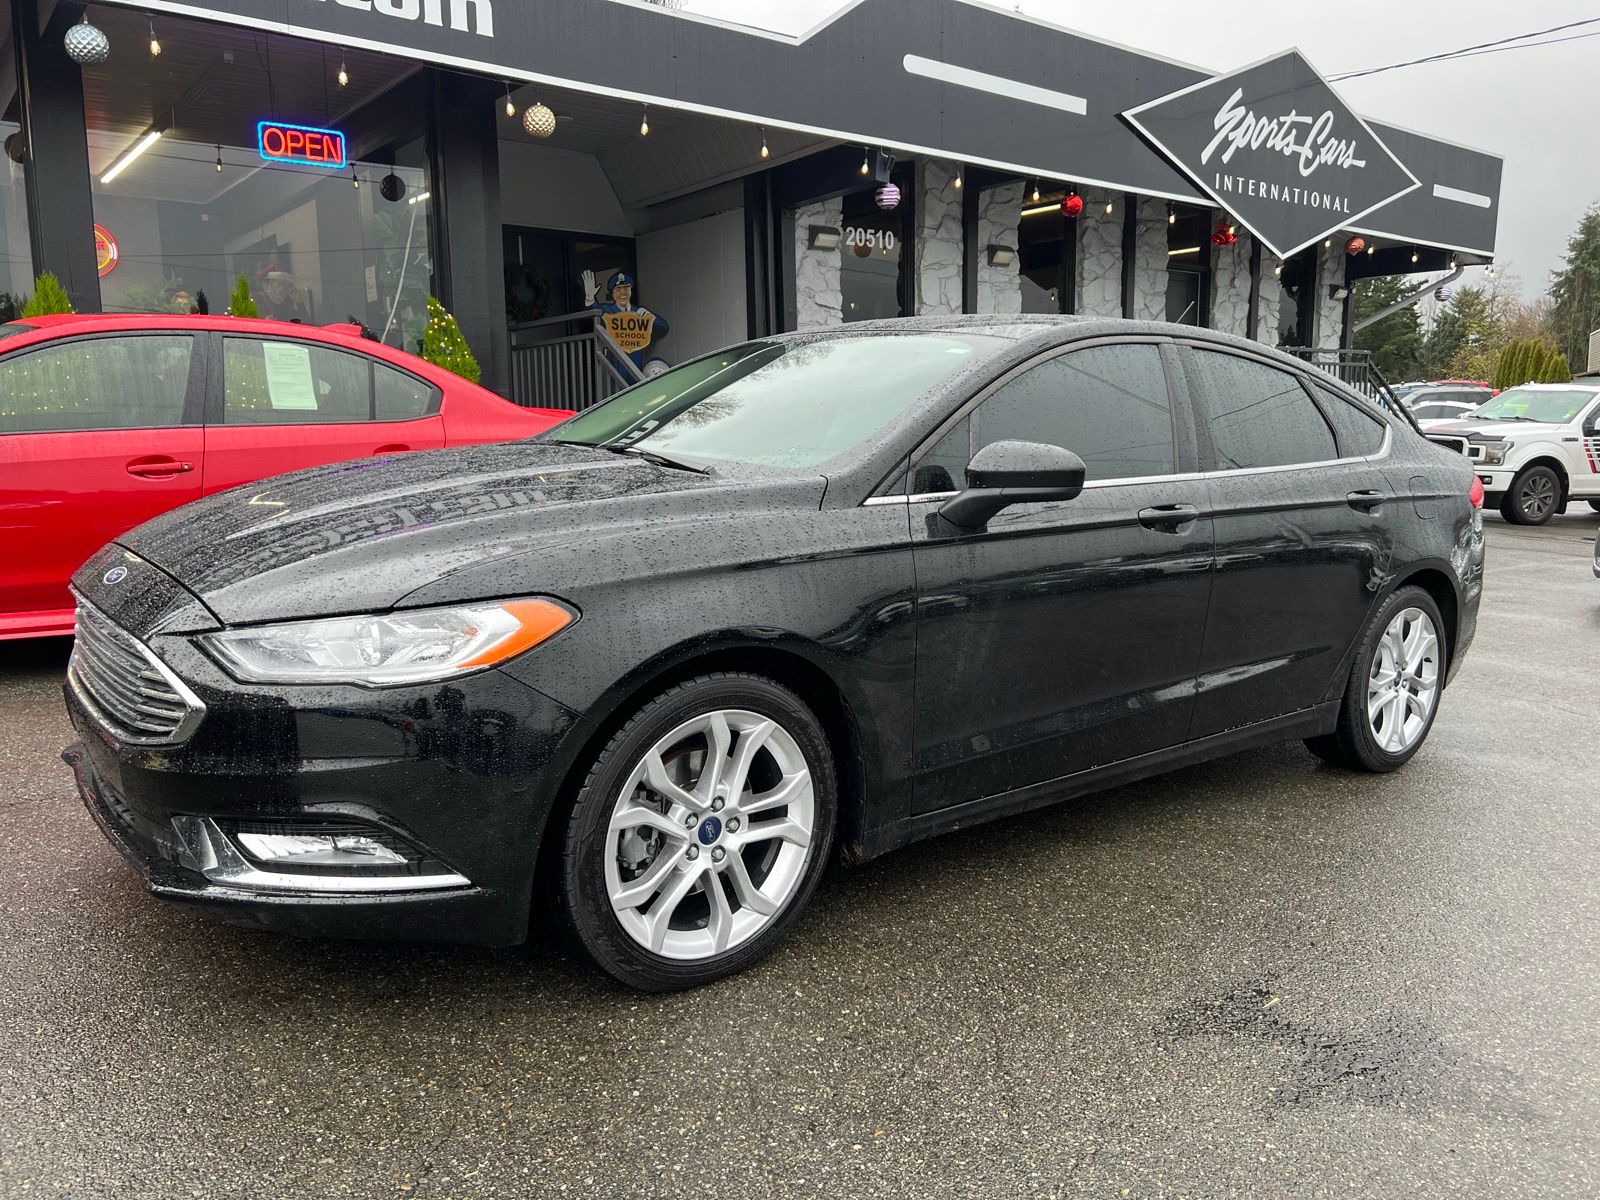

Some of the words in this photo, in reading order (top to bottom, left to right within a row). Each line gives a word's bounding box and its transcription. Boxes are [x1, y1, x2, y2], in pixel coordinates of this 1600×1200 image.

[263, 127, 341, 164] OPEN
[1201, 88, 1313, 165] Sports
[1299, 110, 1366, 177] Cars
[1215, 173, 1350, 213] INTERNATIONAL
[845, 226, 895, 250] 20510
[611, 317, 650, 331] SLOW
[615, 332, 646, 340] SCHOOL
